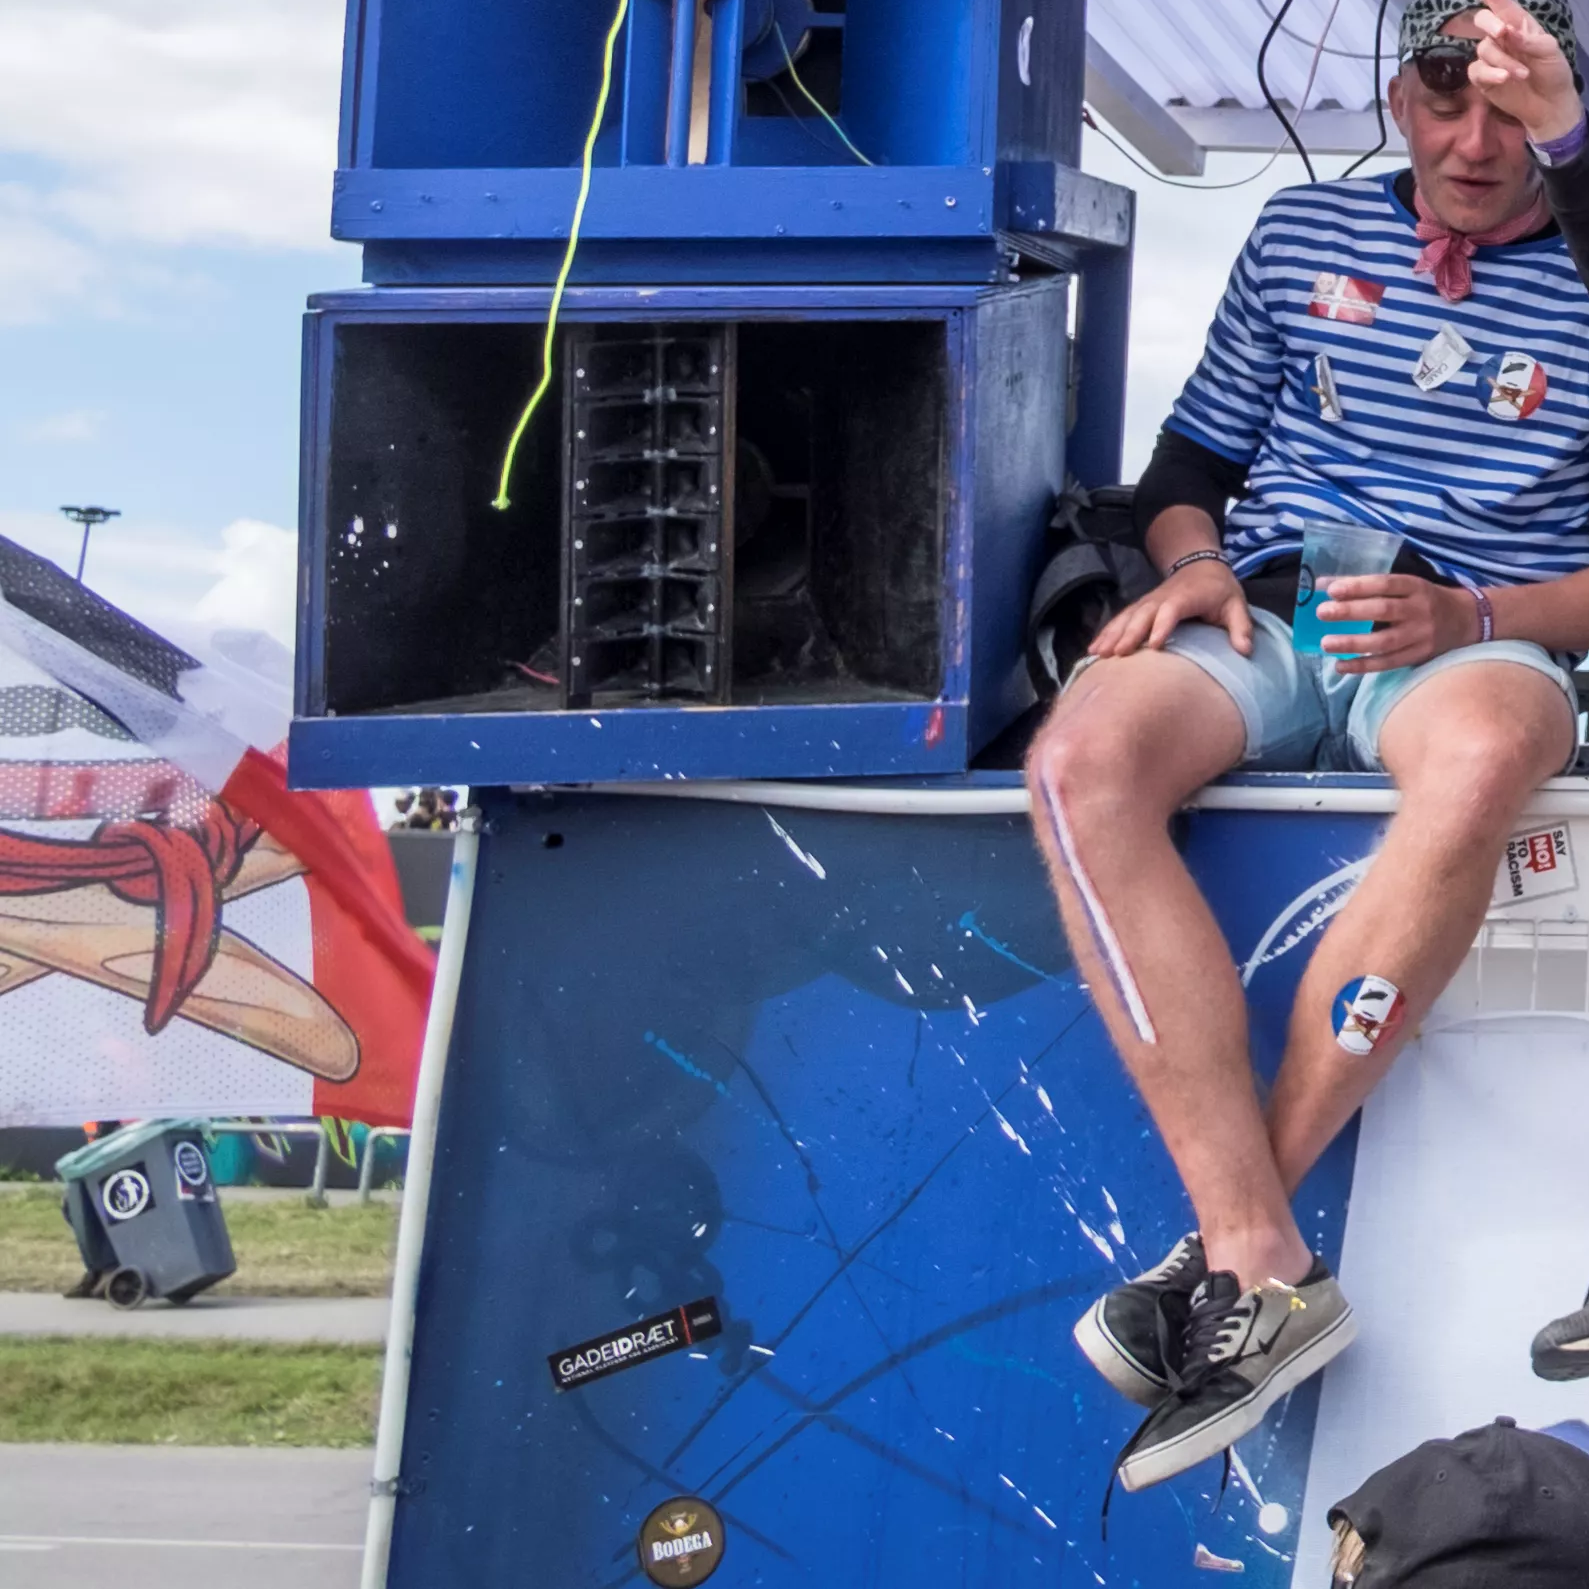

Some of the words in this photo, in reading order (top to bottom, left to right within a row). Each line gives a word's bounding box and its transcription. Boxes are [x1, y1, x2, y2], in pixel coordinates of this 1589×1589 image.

[1516, 837, 1529, 859] TO
[1533, 837, 1552, 870] NO!
[1552, 829, 1567, 857] SAY
[1506, 841, 1525, 897] RACISM
[559, 1319, 676, 1376] GADEIDRÆT
[651, 1530, 713, 1562] BODEGA
